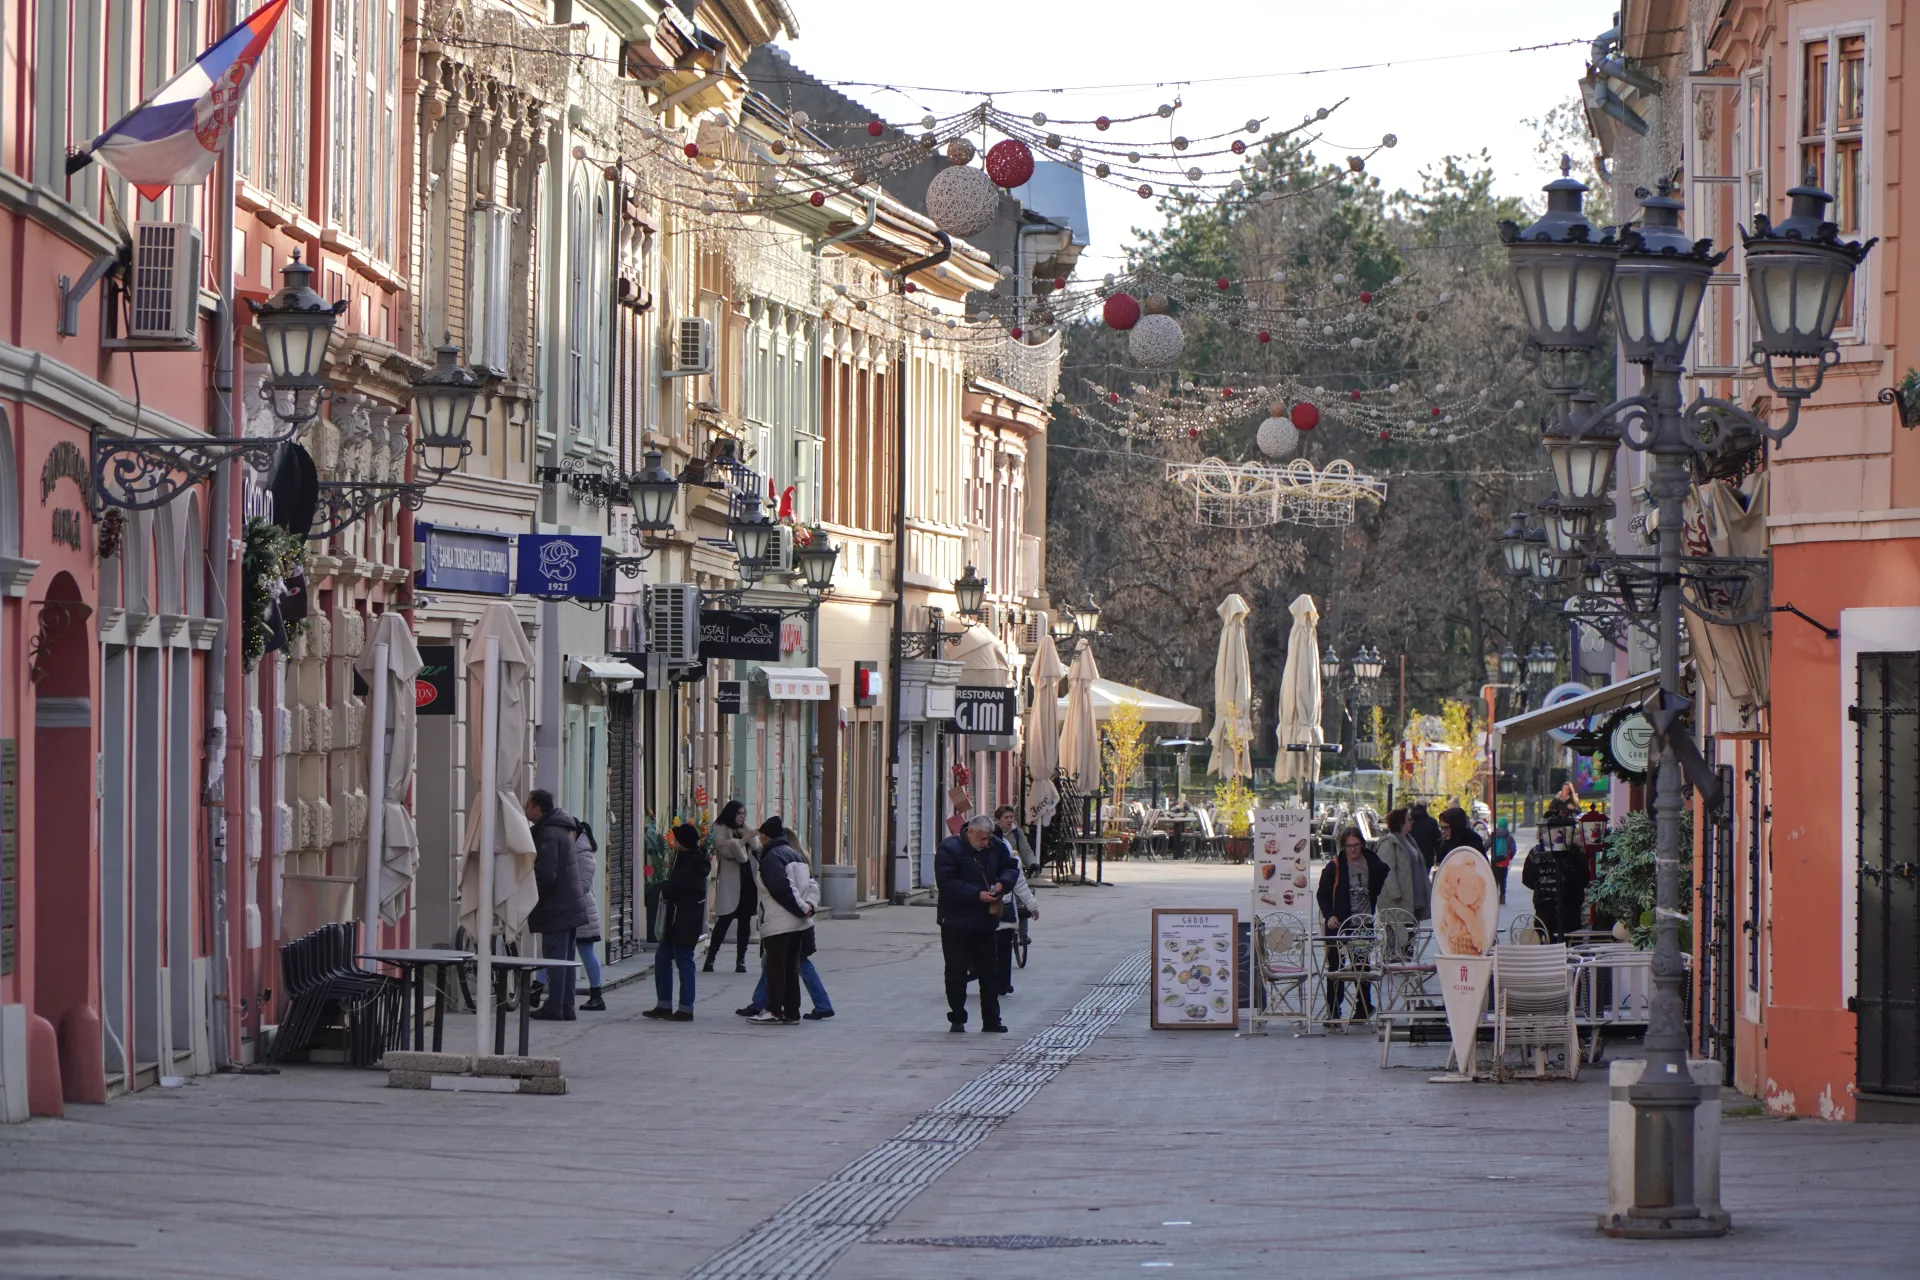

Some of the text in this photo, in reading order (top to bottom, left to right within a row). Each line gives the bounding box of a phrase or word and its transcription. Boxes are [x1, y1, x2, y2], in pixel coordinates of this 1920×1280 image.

[548, 582, 568, 592] 1921
[699, 624, 725, 636] RYSTAL
[420, 665, 447, 676] ar
[956, 689, 1004, 700] RESTORAN
[1270, 814, 1296, 822] GABBY
